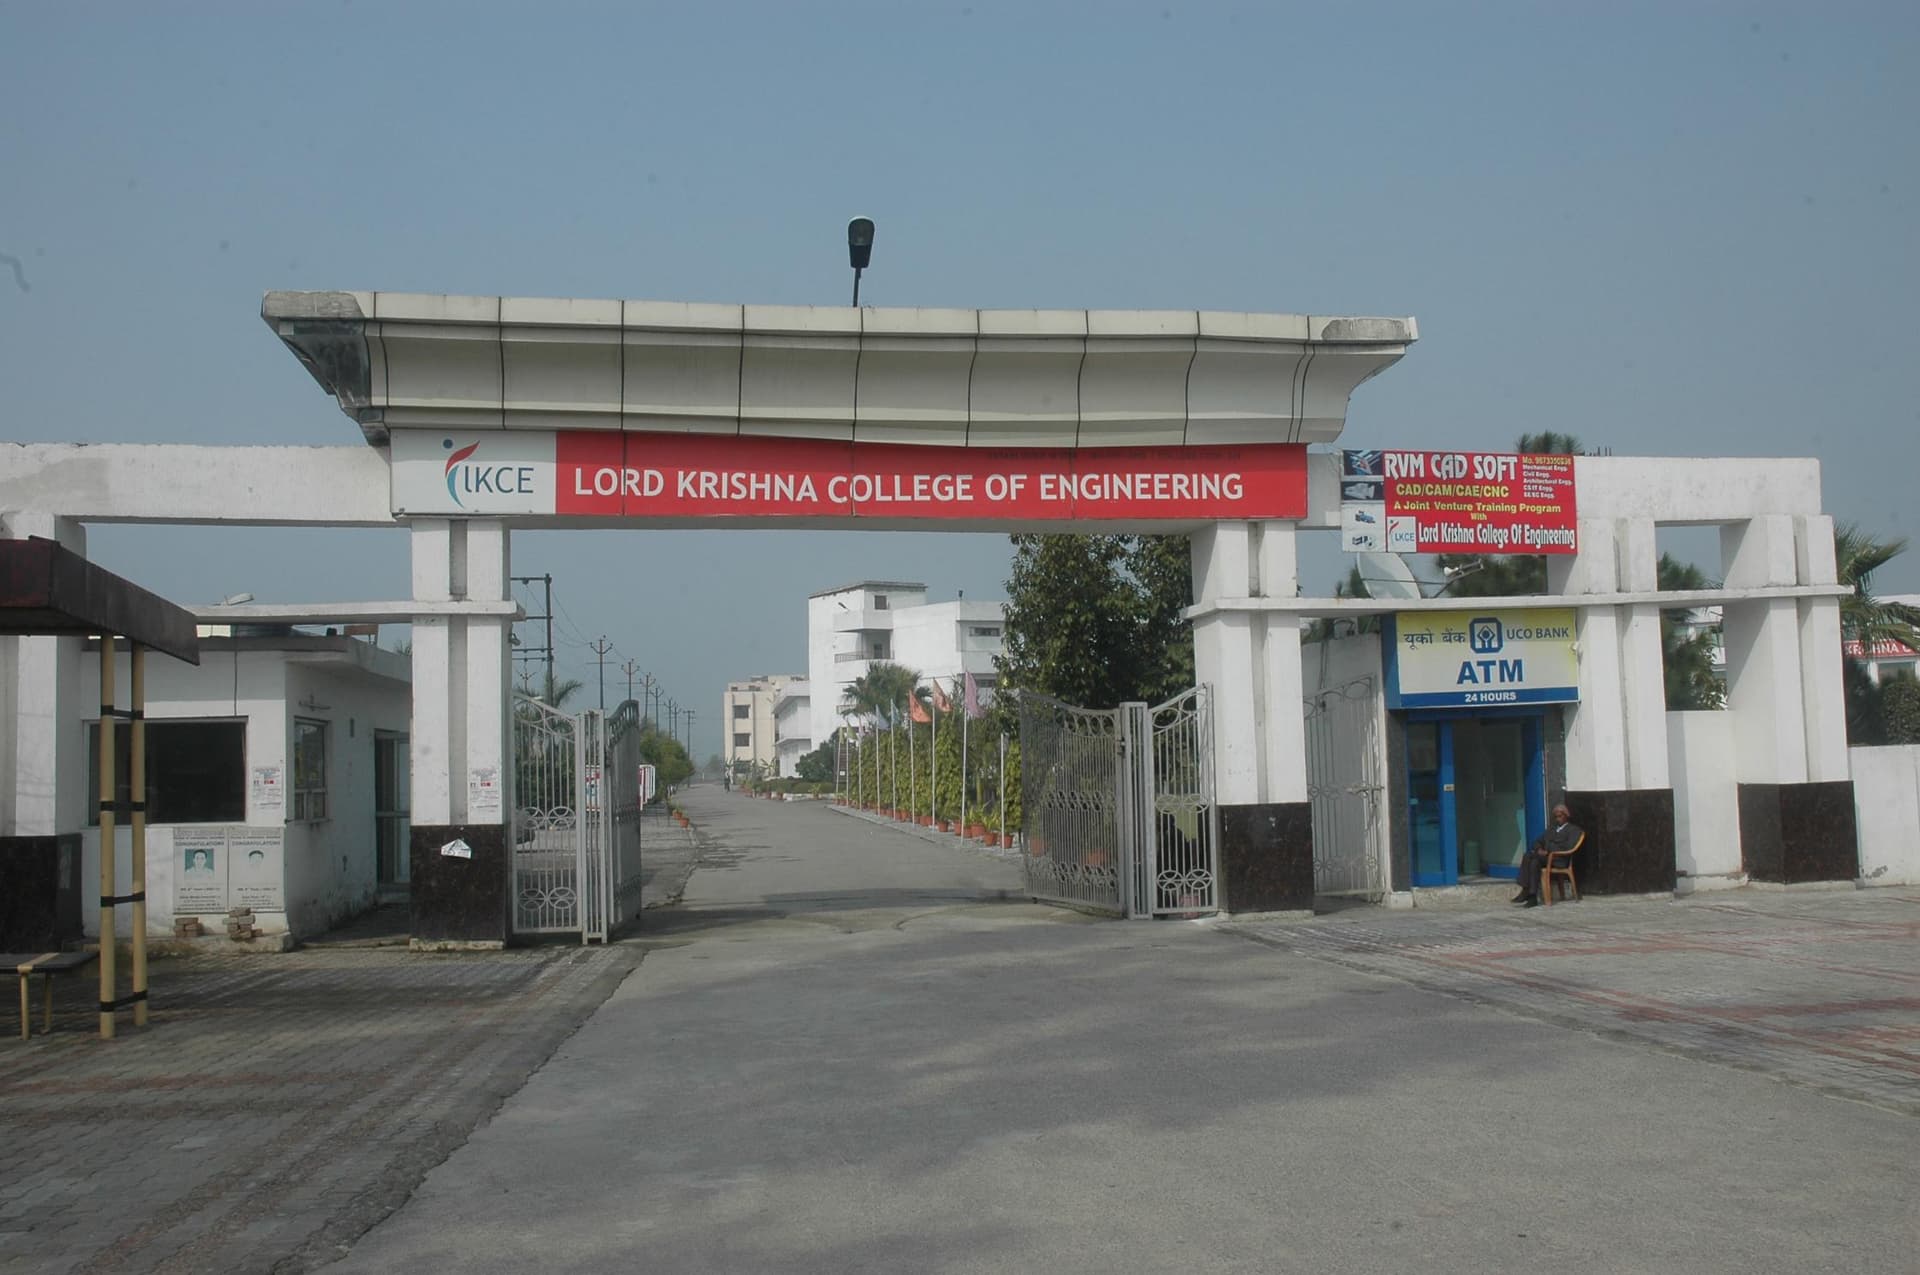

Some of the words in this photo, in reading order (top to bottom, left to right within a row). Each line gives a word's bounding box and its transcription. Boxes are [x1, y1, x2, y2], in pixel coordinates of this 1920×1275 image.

[1384, 453, 1424, 480] RVM
[1431, 454, 1468, 480] CAD
[1473, 455, 1517, 482] SOFT
[575, 467, 665, 498] LORD
[677, 470, 818, 503] KRISHNA
[828, 473, 974, 503] COLLEGE
[985, 473, 1027, 502] OF
[1040, 472, 1243, 501] ENGINEERING
[1396, 483, 1509, 498] CAD/CAM/CAE/CNC
[1394, 501, 1401, 510] A
[1404, 501, 1430, 511] Joint
[1434, 502, 1473, 511] Venture
[1476, 503, 1517, 514] Training
[1519, 504, 1561, 514] Program
[1471, 512, 1487, 521] With
[1418, 522, 1438, 543] Lord
[1441, 522, 1474, 544] Krishna
[1477, 523, 1508, 548] College
[1511, 524, 1523, 544] Of
[1525, 525, 1575, 549] Engineering
[1506, 628, 1532, 640] UCO
[1536, 627, 1569, 639] BANK
[1456, 658, 1524, 685] ATM
[1465, 693, 1477, 702] 24
[1480, 692, 1516, 702] HOURS
